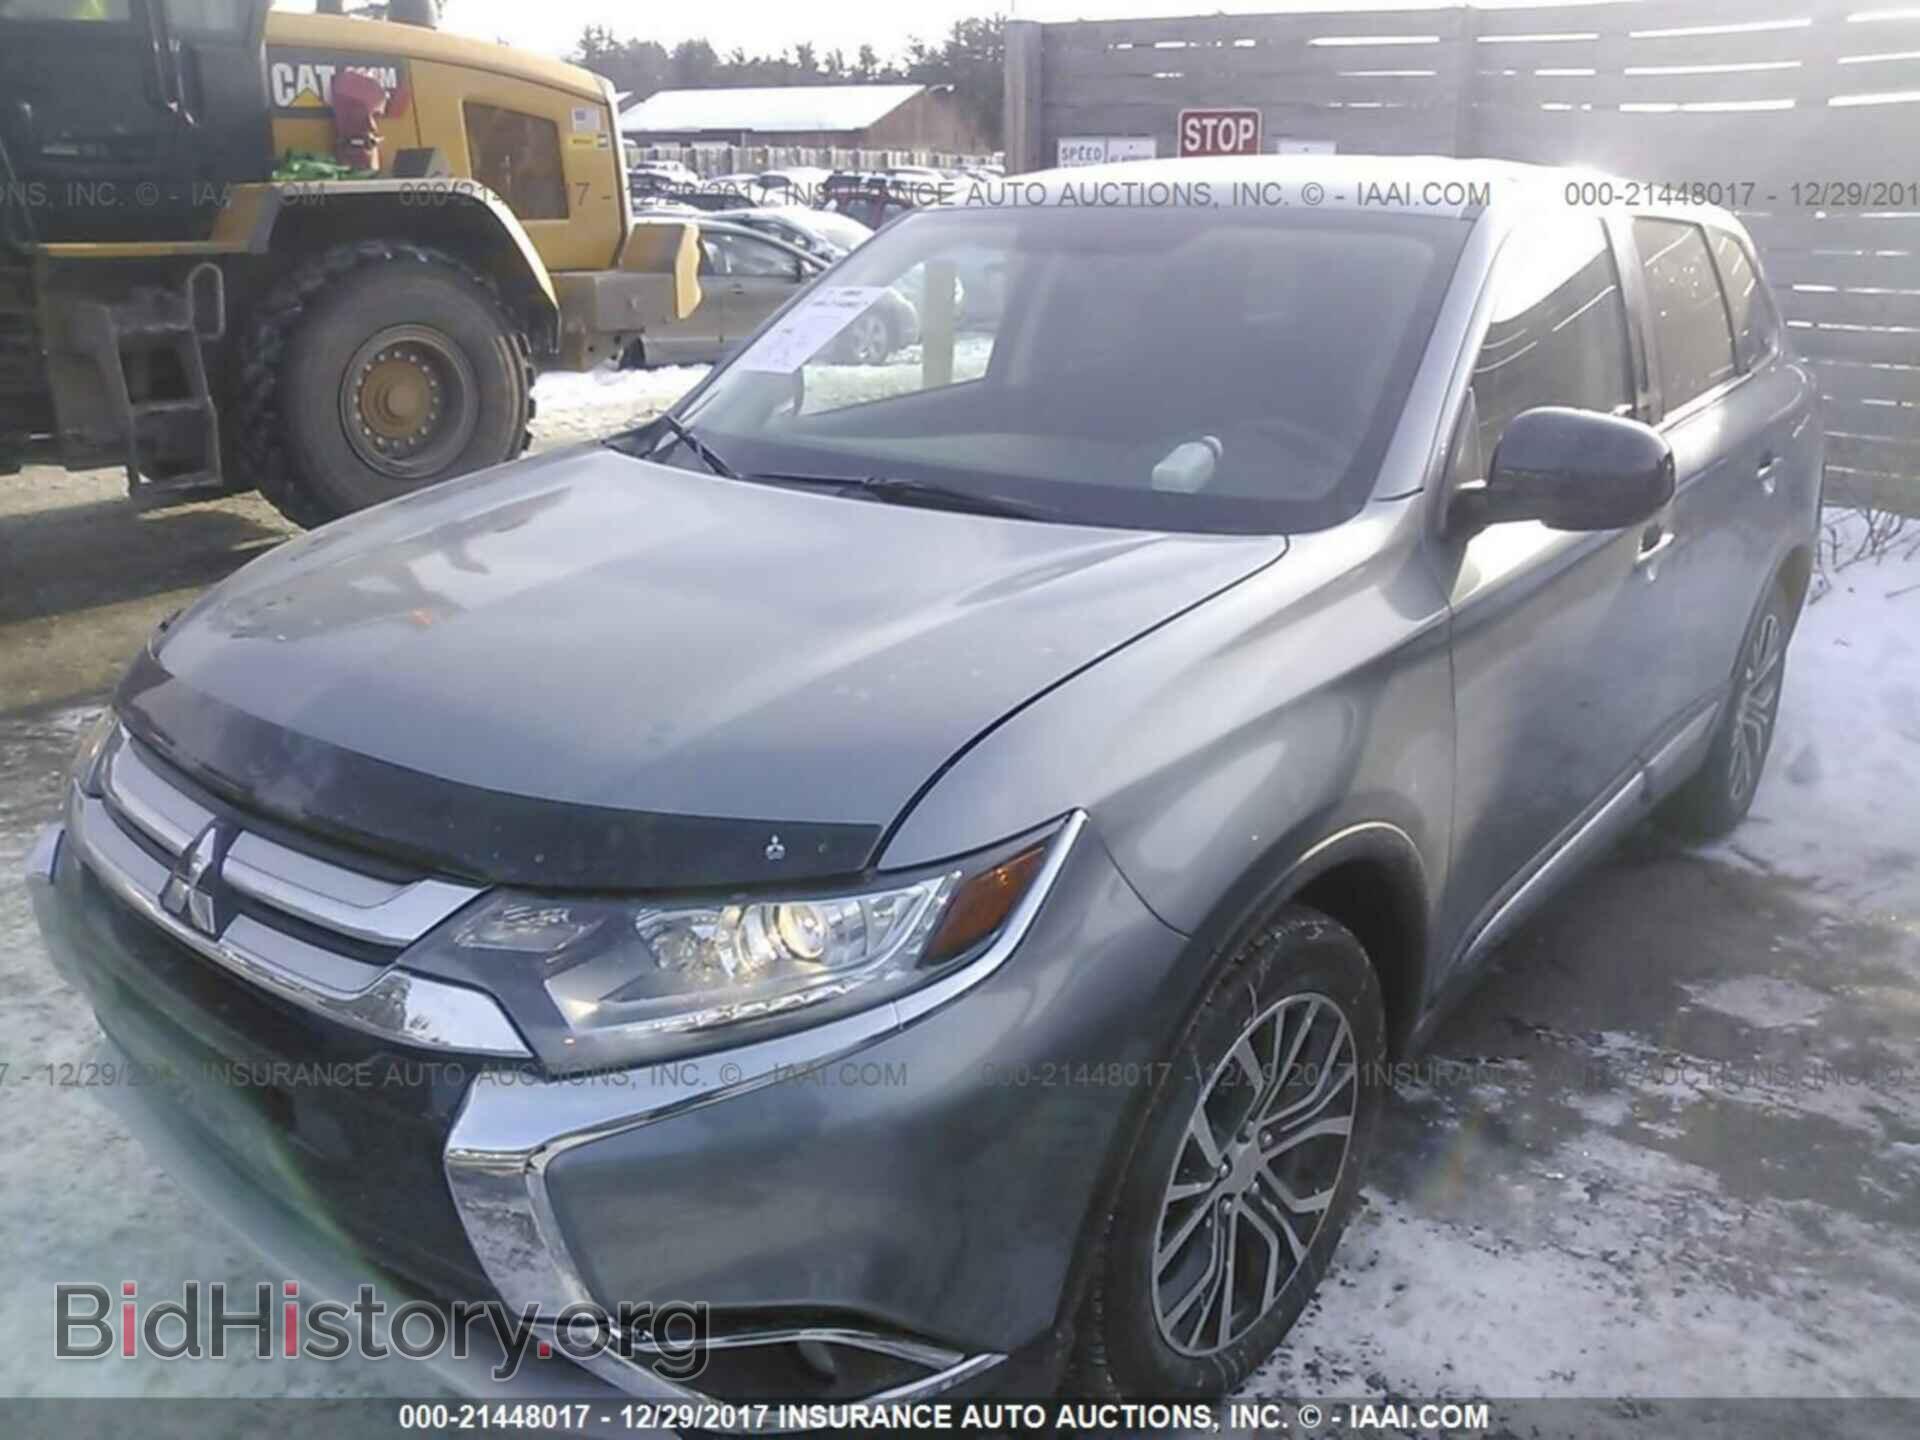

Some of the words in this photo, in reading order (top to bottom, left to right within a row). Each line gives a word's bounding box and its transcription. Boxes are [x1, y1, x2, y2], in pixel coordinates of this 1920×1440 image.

[272, 62, 336, 107] CAT
[1184, 118, 1255, 151] STOP
[1062, 145, 1102, 161] SPEED
